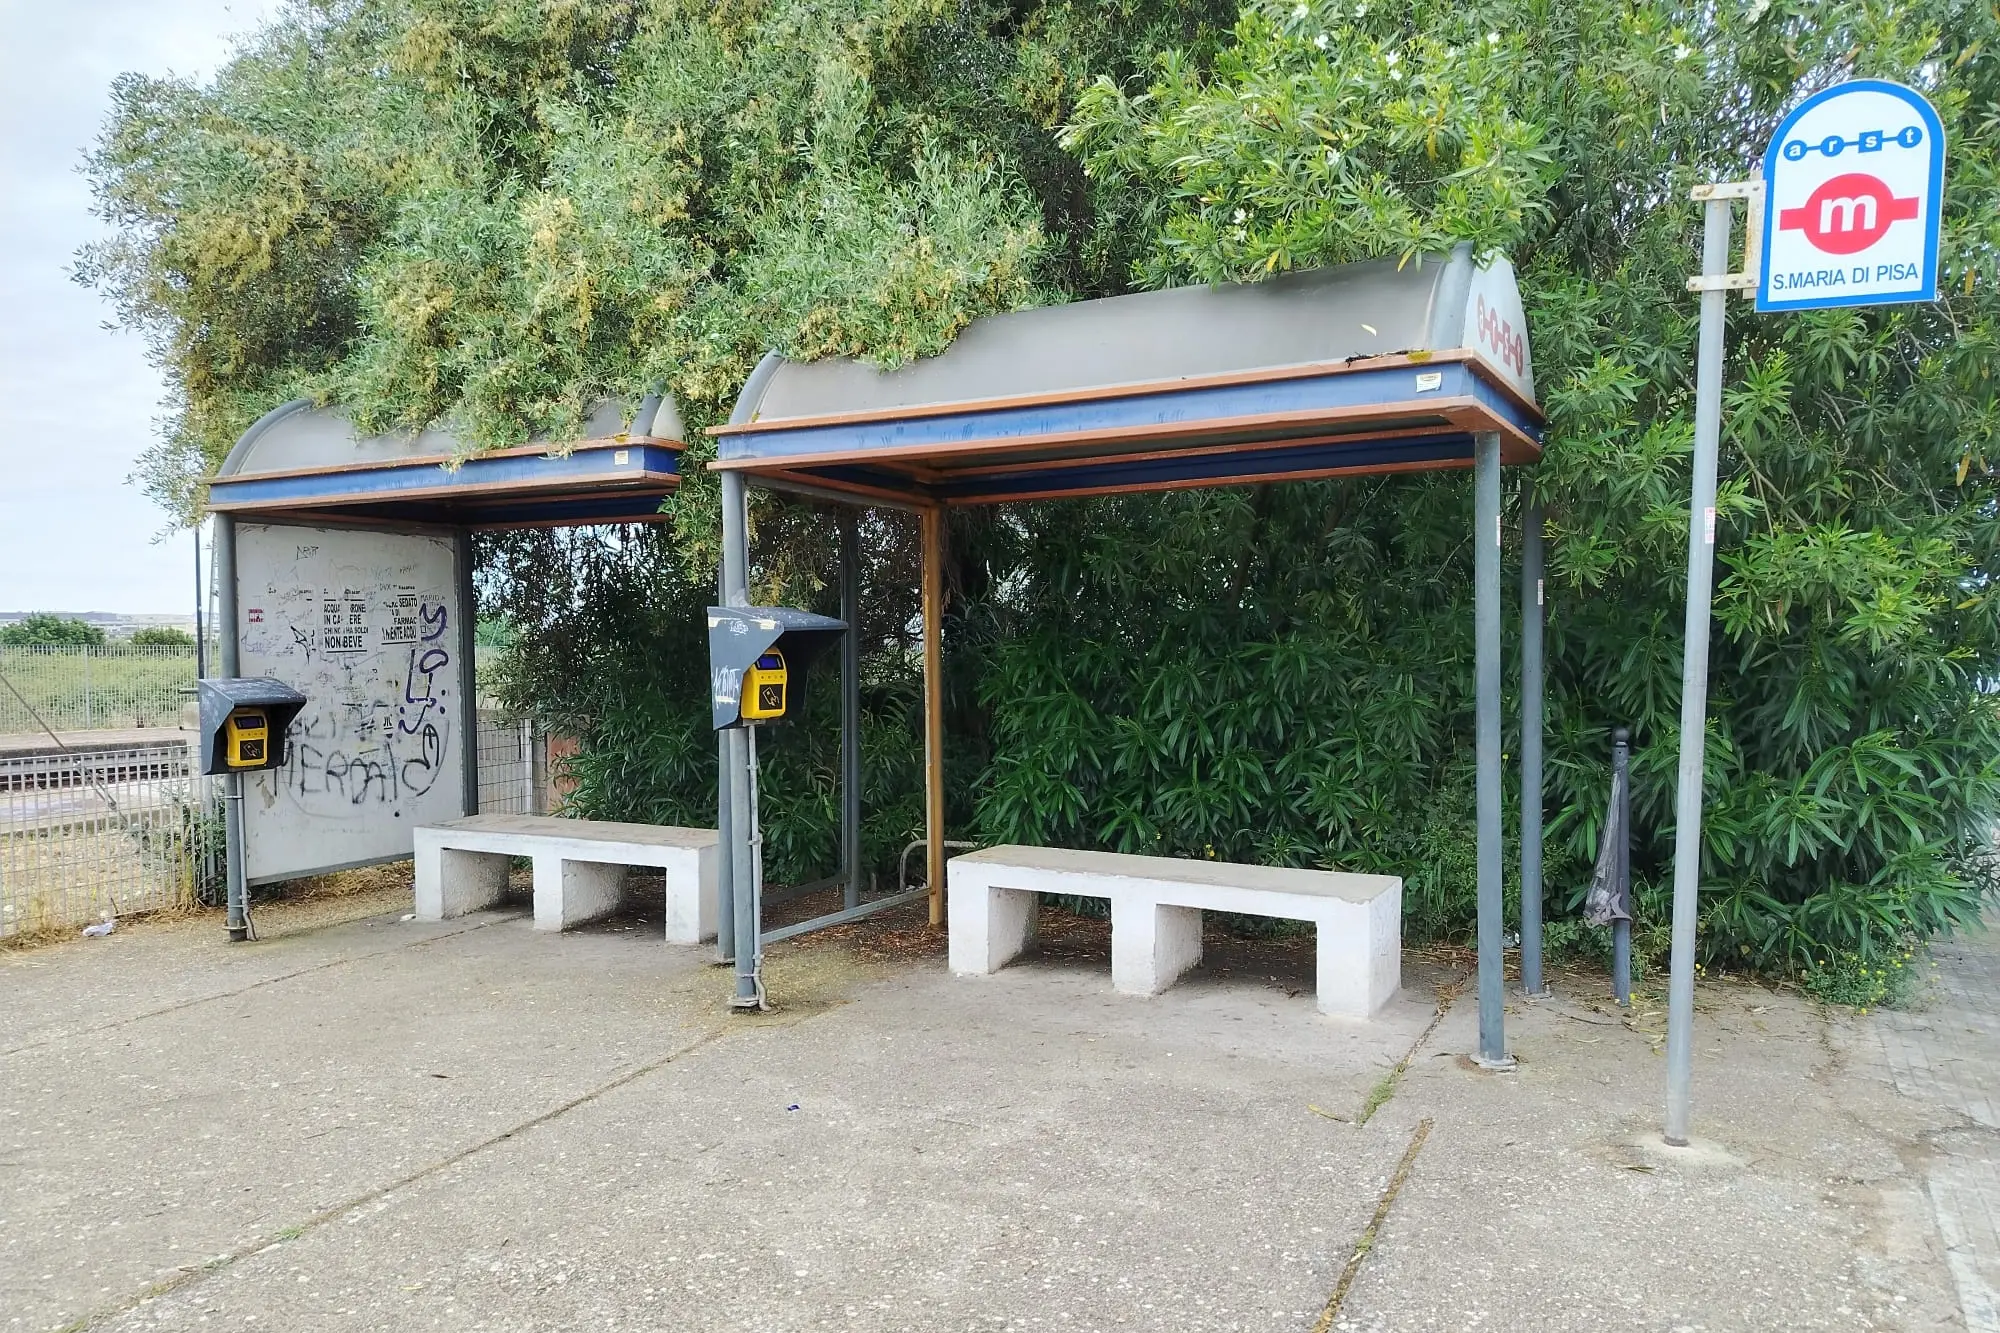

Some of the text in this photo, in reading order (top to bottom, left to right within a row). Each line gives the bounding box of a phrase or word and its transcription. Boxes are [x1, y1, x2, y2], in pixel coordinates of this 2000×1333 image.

[1785, 125, 1920, 160] arst
[1818, 193, 1878, 234] m
[1773, 262, 1919, 290] S.MARIA DI PISA
[398, 597, 418, 607] SEDATO
[332, 614, 362, 624] CAERE
[325, 635, 363, 648] NON BEVE
